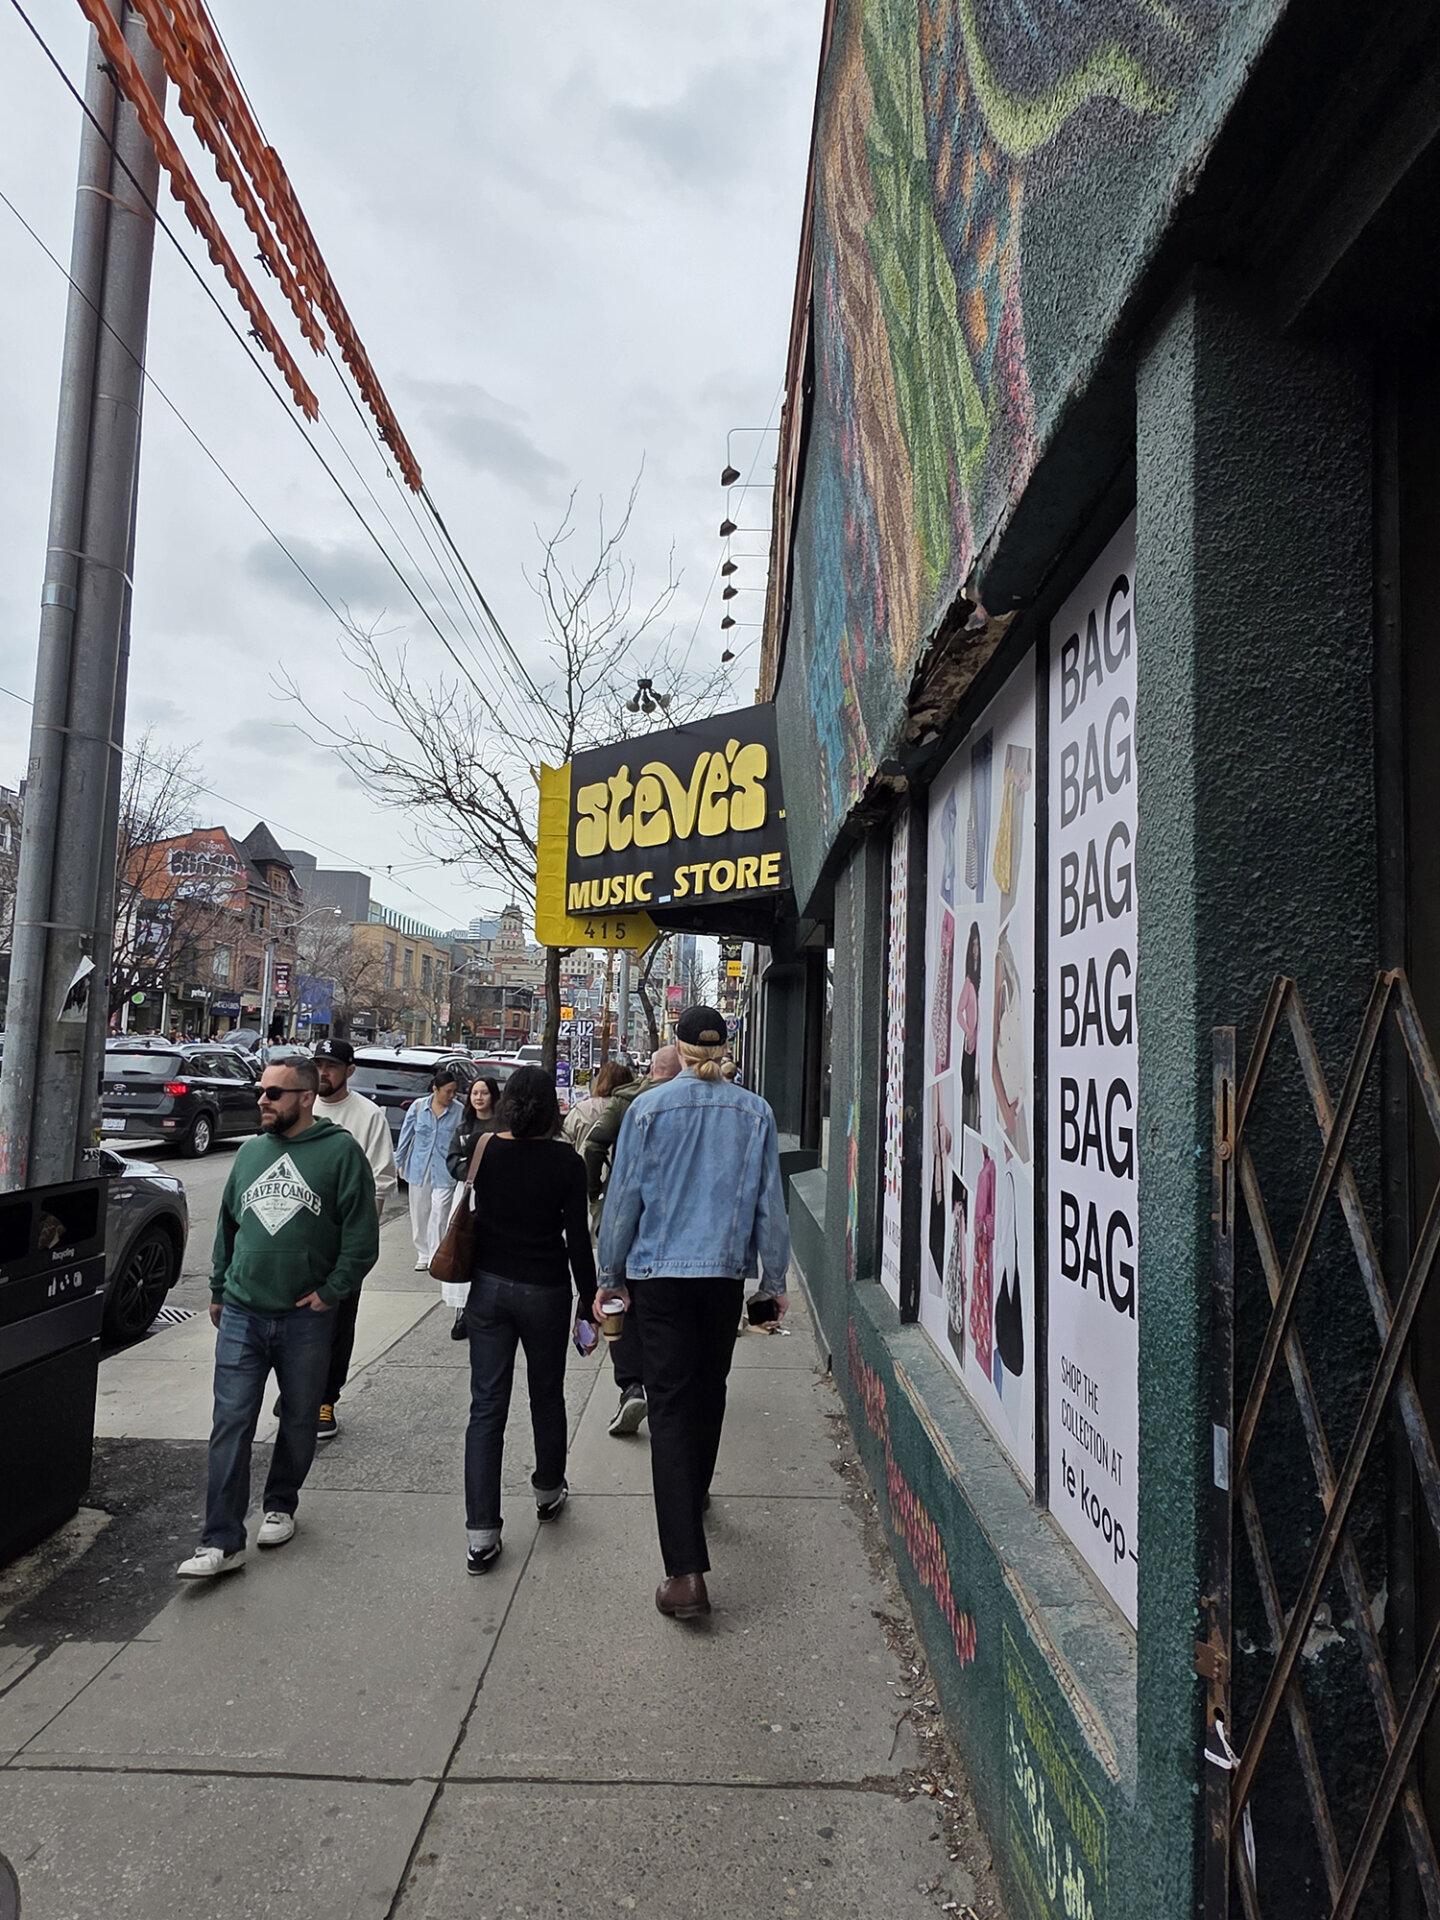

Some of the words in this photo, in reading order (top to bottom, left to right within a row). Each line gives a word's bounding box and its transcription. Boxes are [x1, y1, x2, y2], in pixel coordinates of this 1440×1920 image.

[1060, 573, 1131, 724] BAG
[1060, 696, 1131, 830] BAG
[567, 871, 654, 911] MUSIC
[673, 852, 782, 898] STORE
[1060, 820, 1131, 938] BAG
[583, 922, 626, 940] 415
[1060, 947, 1133, 1048] BAG
[1060, 1076, 1133, 1180] BAG
[1060, 1190, 1135, 1320] BAG
[1060, 1355, 1082, 1398] SHOP
[1083, 1373, 1099, 1416] THE
[1060, 1398, 1109, 1473] COLLECTION
[1110, 1448, 1123, 1487] AT
[1062, 1448, 1076, 1498] te
